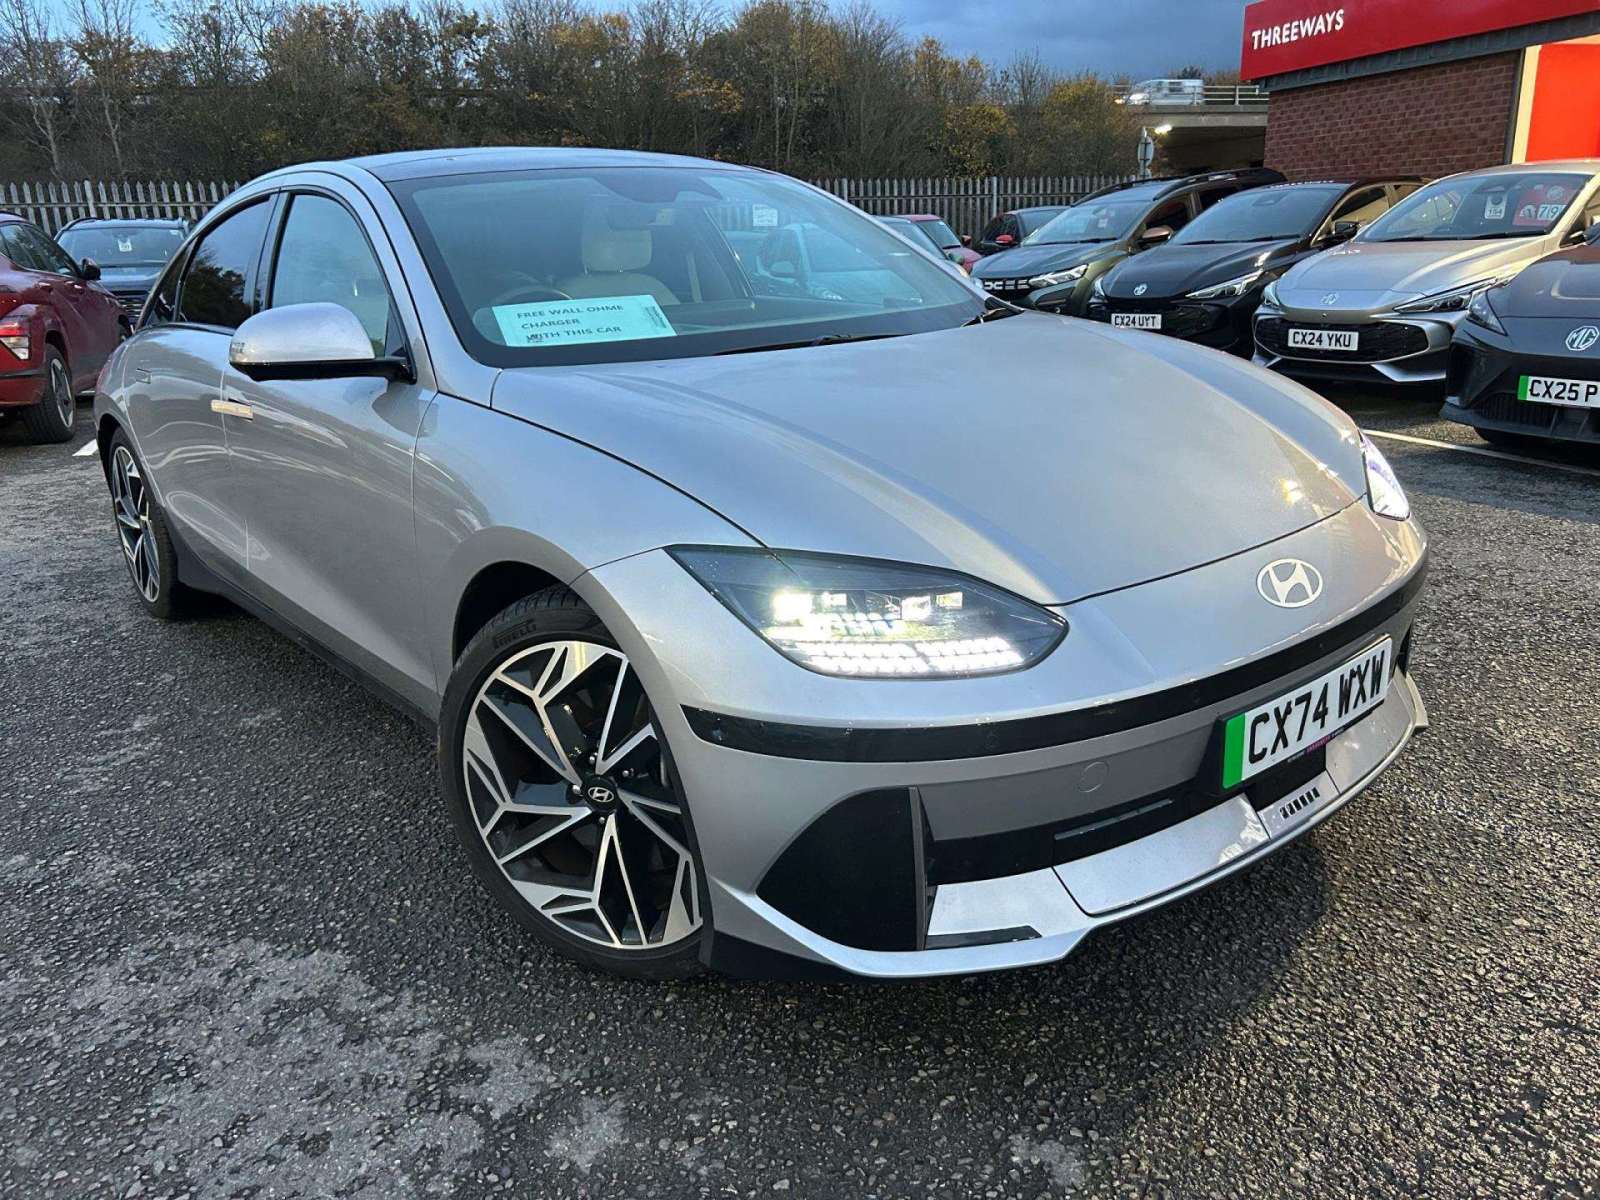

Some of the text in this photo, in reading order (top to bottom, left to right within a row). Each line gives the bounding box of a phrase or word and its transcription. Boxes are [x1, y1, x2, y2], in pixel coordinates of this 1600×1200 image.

[1251, 9, 1344, 50] THREEWAYS
[517, 304, 624, 319] FREE WALL OHME
[521, 318, 580, 330] CHARGER
[1114, 315, 1157, 327] CX24 UYT
[564, 328, 593, 337] THIS
[596, 325, 622, 334] CAR
[1293, 331, 1352, 348] CX24 YKU
[1566, 326, 1599, 350] MG
[1529, 379, 1580, 401] CX25
[1249, 682, 1329, 764] CX74
[1338, 650, 1385, 719] WXW
